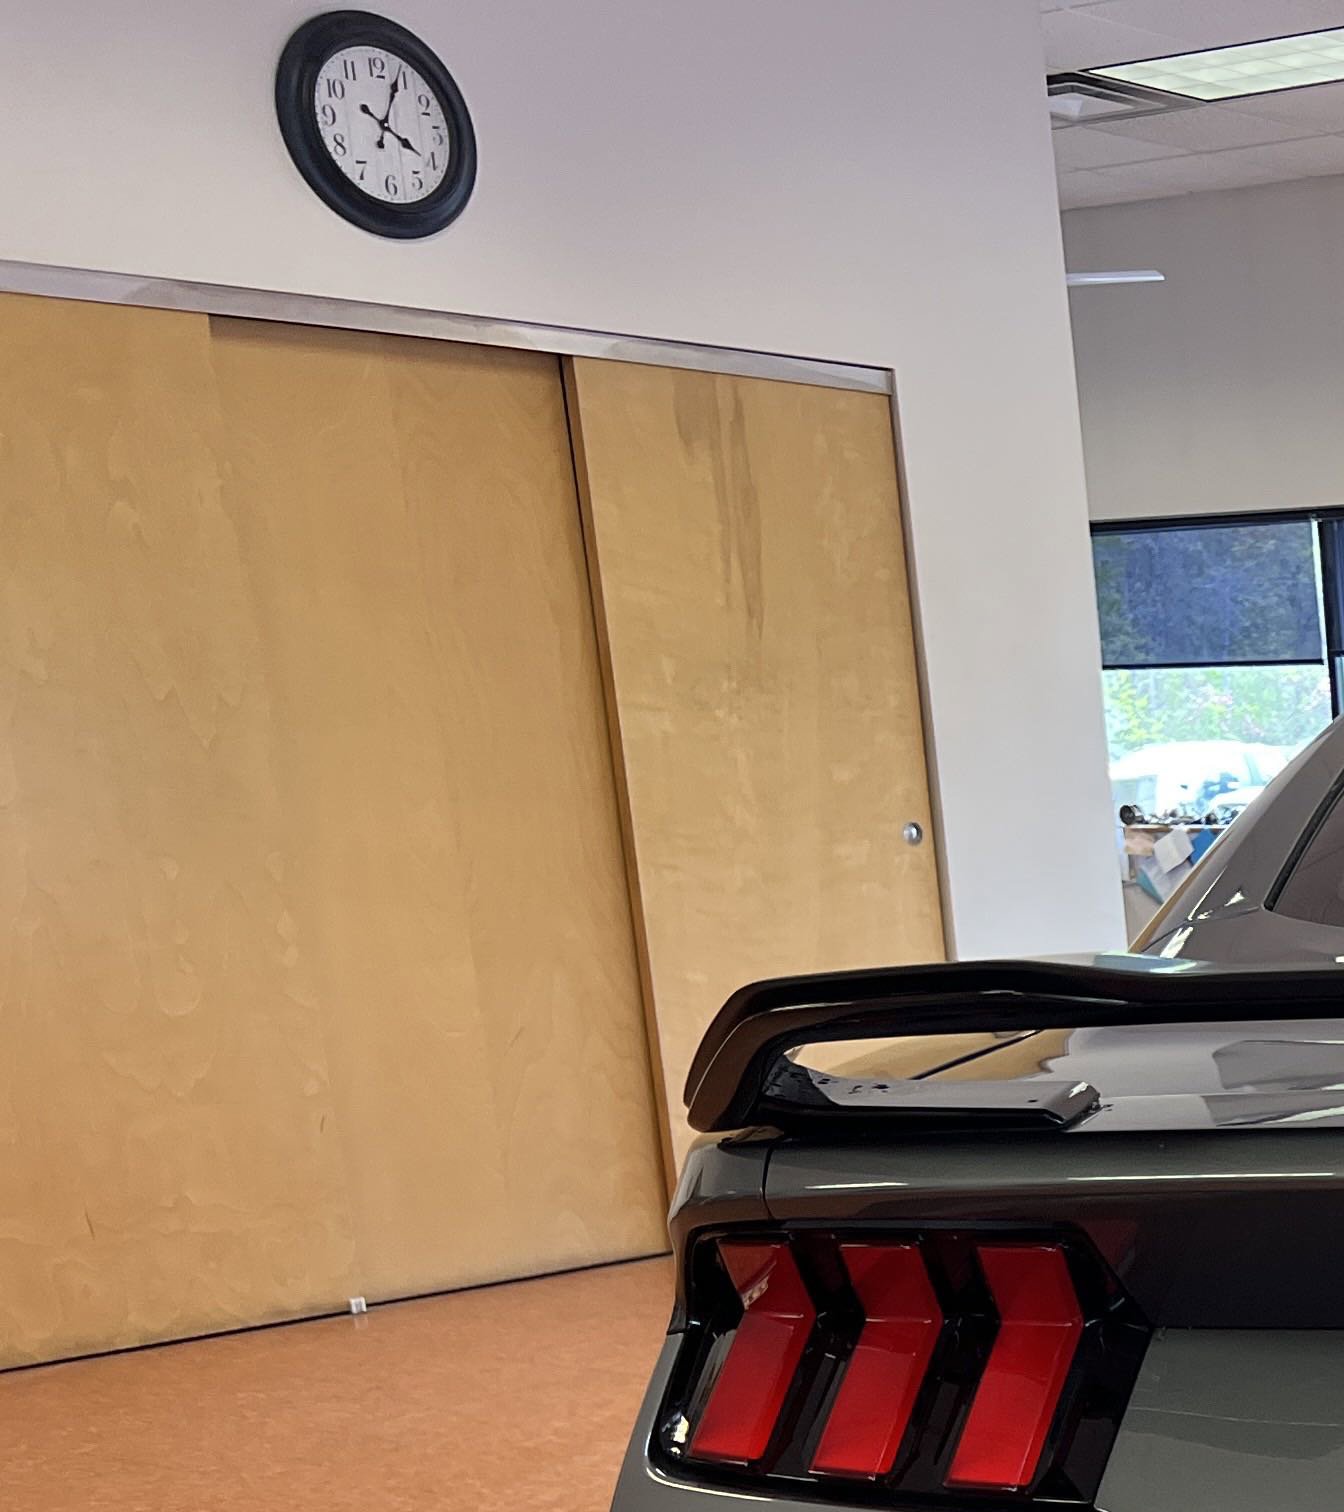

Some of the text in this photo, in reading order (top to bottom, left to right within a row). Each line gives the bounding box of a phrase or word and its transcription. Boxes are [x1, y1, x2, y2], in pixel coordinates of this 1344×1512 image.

[343, 59, 357, 81] 11
[368, 57, 386, 79] 12
[326, 78, 345, 99] 10
[401, 71, 408, 90] 1
[321, 104, 336, 126] 9
[418, 94, 430, 116] 2
[333, 133, 347, 157] 8
[432, 126, 443, 146] 3
[355, 160, 367, 181] 7
[427, 152, 437, 171] 4
[385, 175, 398, 196] 6
[412, 171, 423, 191] 5
